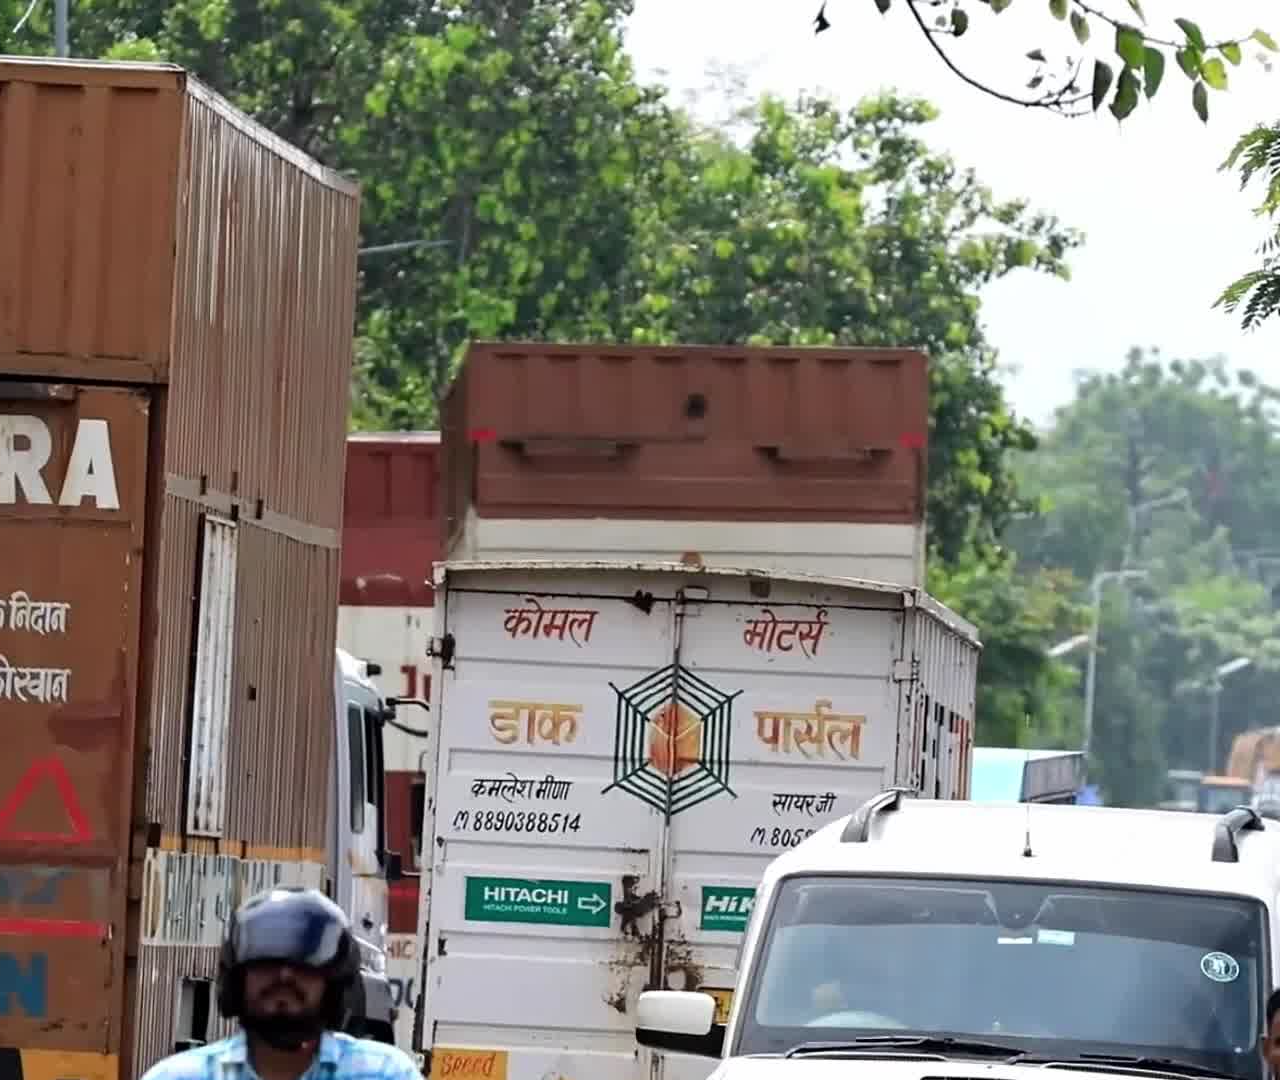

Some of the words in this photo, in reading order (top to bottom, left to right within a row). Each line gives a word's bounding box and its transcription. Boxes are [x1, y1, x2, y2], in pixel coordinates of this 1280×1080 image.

[8, 590, 71, 635] निदान
[504, 599, 598, 647] कोमल
[743, 608, 829, 658] मोटर्स
[488, 700, 583, 747] डाक
[754, 698, 866, 761] पार्सल
[471, 772, 535, 803] कमलेश
[536, 775, 574, 801] मीणा
[473, 810, 581, 833] 8890388514
[484, 886, 569, 905] HITACHI
